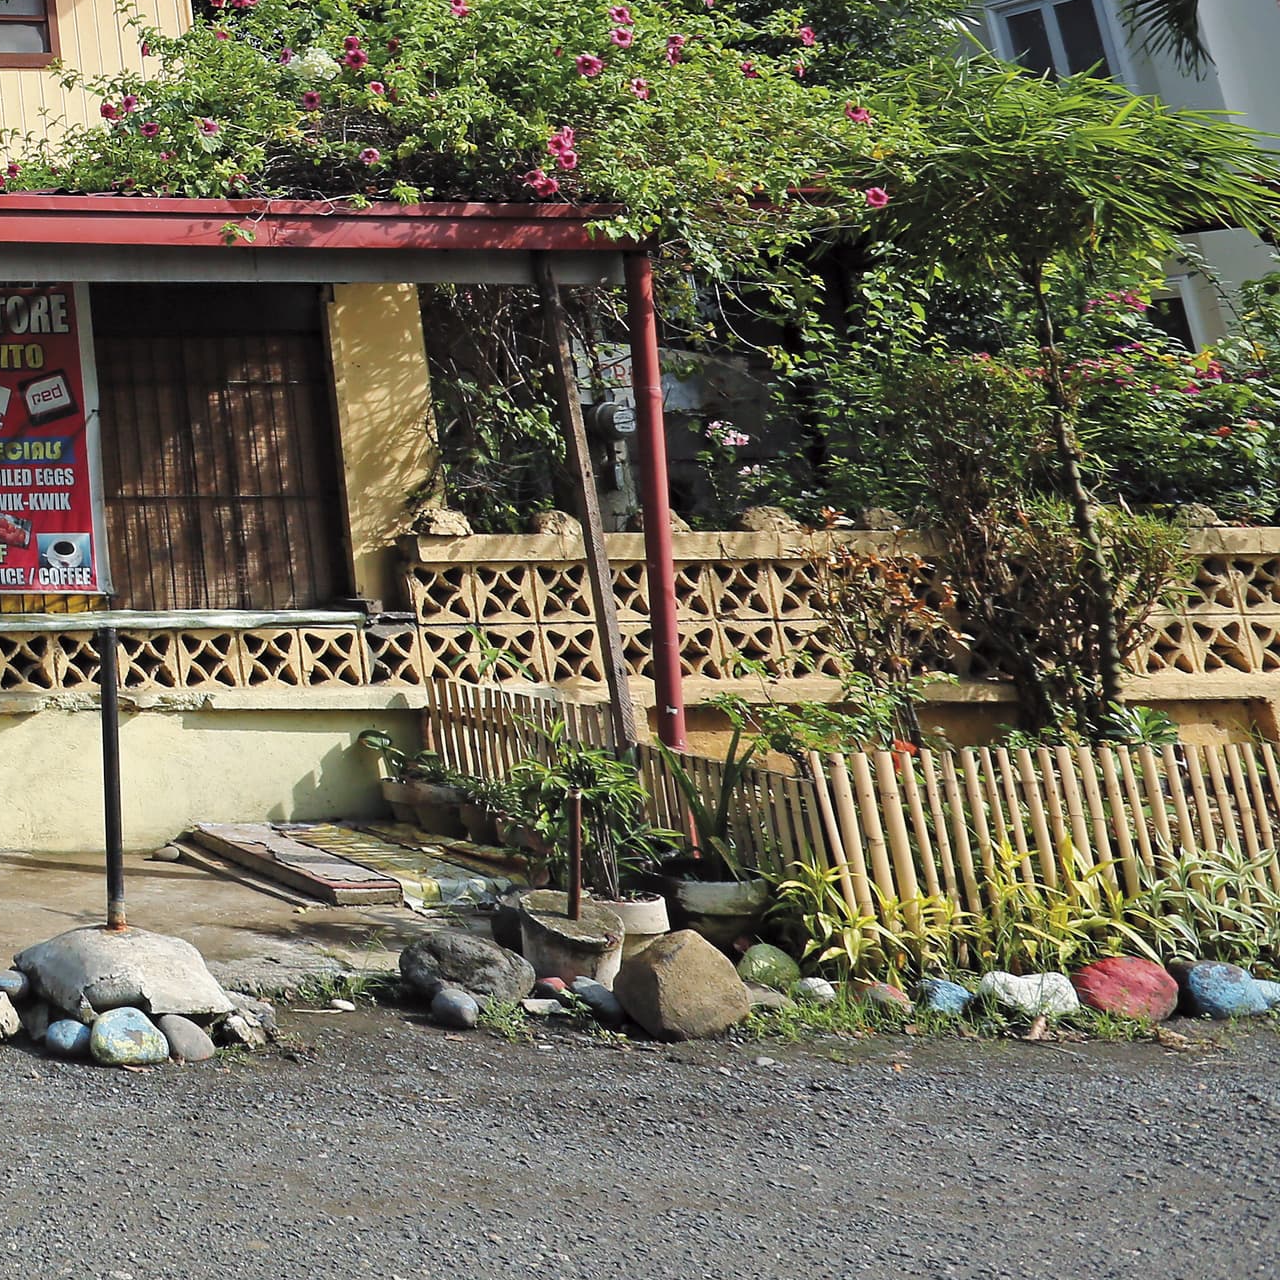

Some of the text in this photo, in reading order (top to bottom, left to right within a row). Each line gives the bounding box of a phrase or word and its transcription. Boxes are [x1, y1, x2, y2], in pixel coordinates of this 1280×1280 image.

[32, 384, 63, 405] red
[35, 468, 75, 486] EGGS
[38, 567, 91, 585] COFFEE
